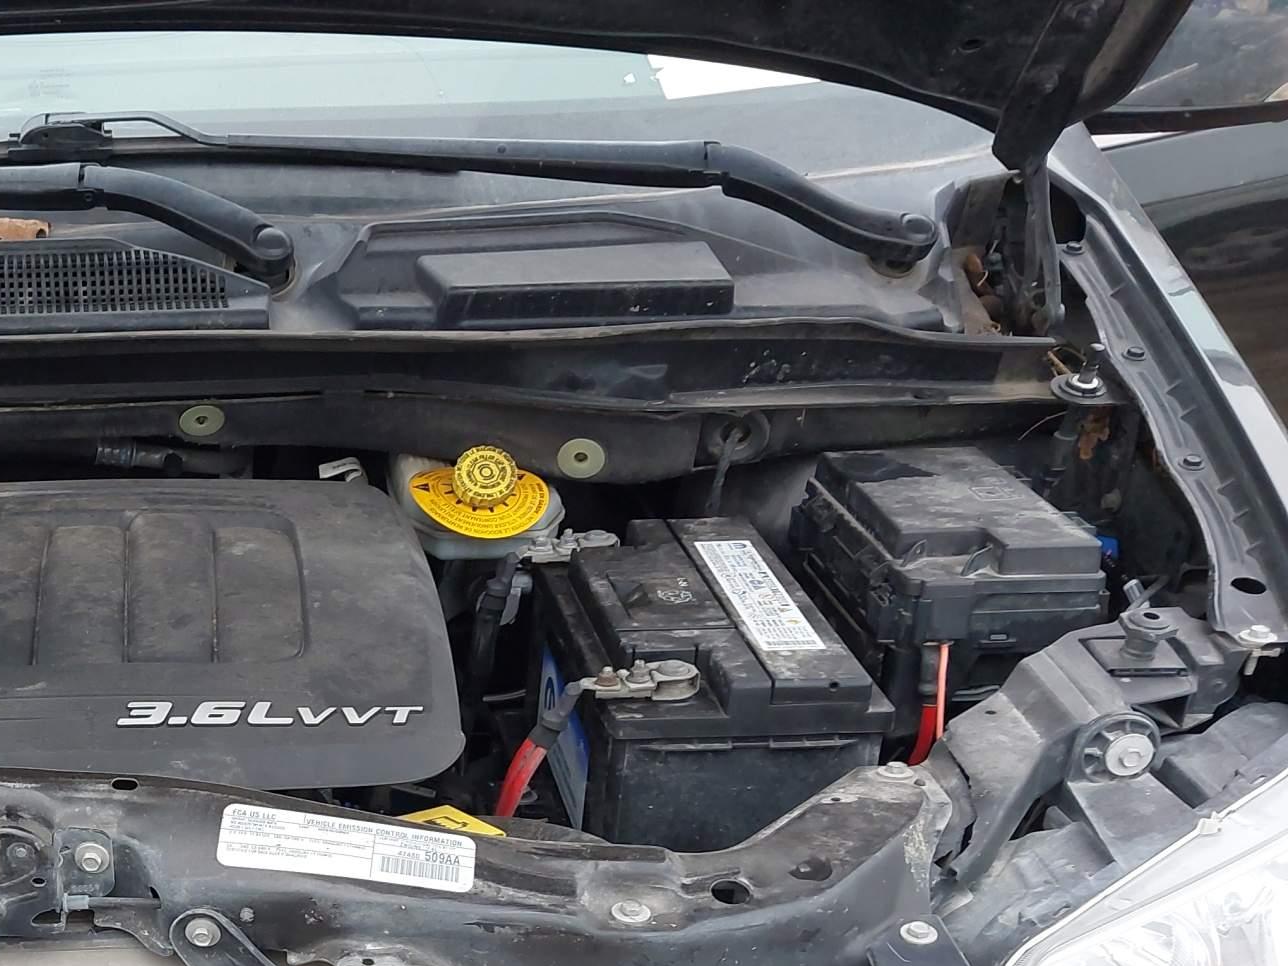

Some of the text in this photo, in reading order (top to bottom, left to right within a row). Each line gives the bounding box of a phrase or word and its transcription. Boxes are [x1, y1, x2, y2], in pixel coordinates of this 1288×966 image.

[306, 817, 336, 829] VEHICLE
[338, 822, 374, 834] EMISSION
[375, 828, 408, 839] CONTROL
[411, 832, 463, 847] INFORMATION
[424, 851, 461, 865] 509AA
